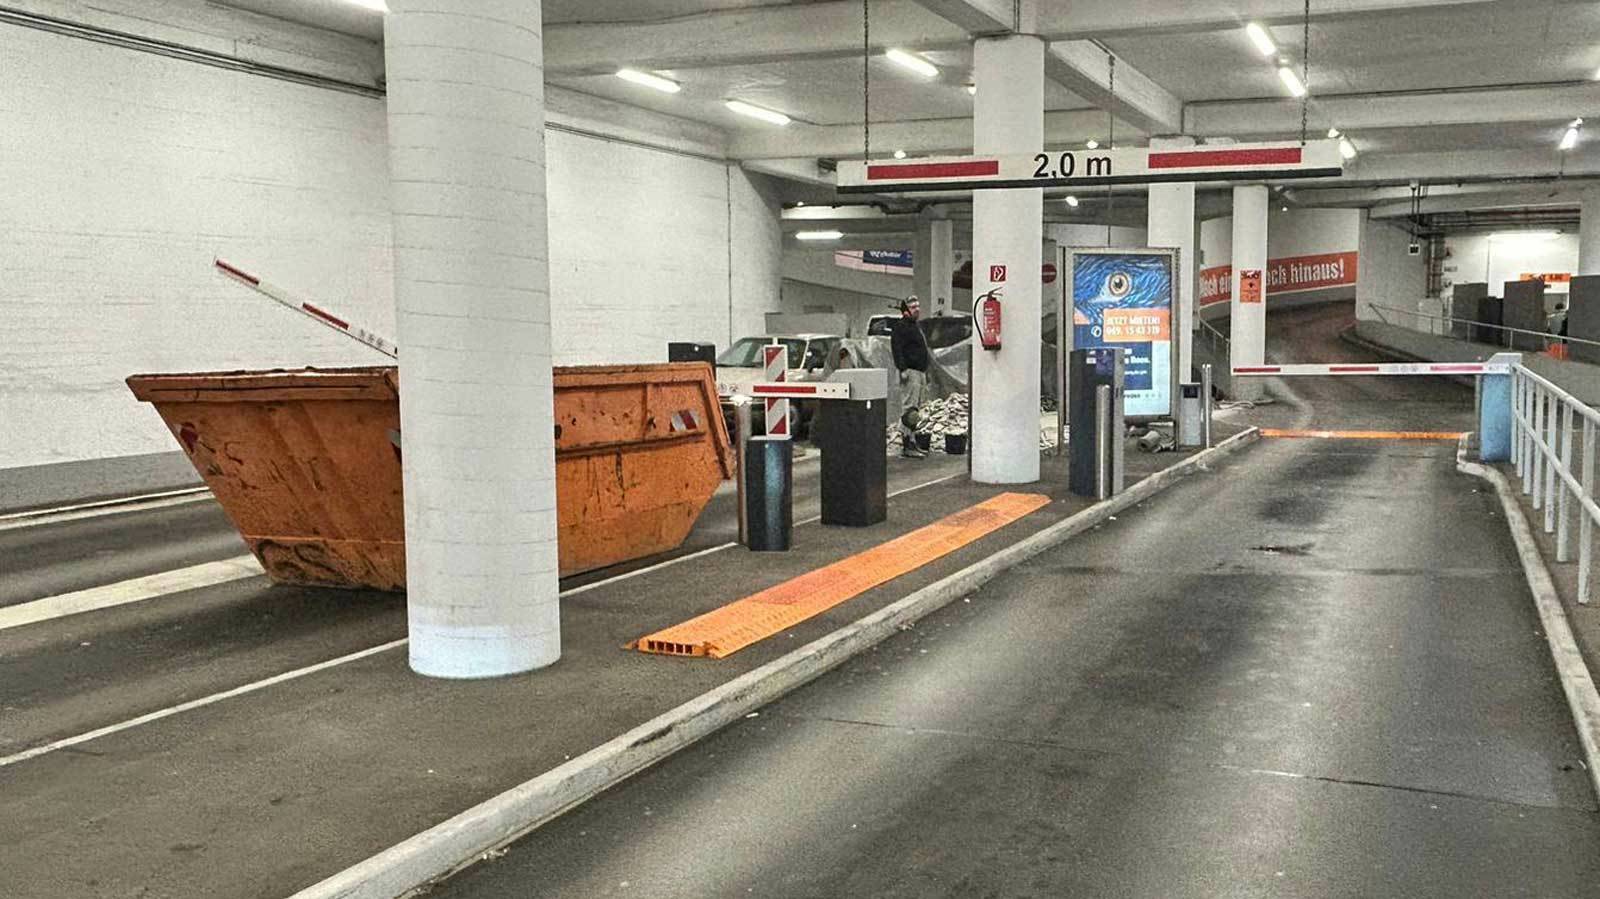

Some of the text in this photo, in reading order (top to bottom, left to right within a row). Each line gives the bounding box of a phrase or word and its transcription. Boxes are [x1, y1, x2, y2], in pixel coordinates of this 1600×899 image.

[1033, 152, 1111, 178] 2,0 m
[1290, 257, 1346, 285] hinaus!
